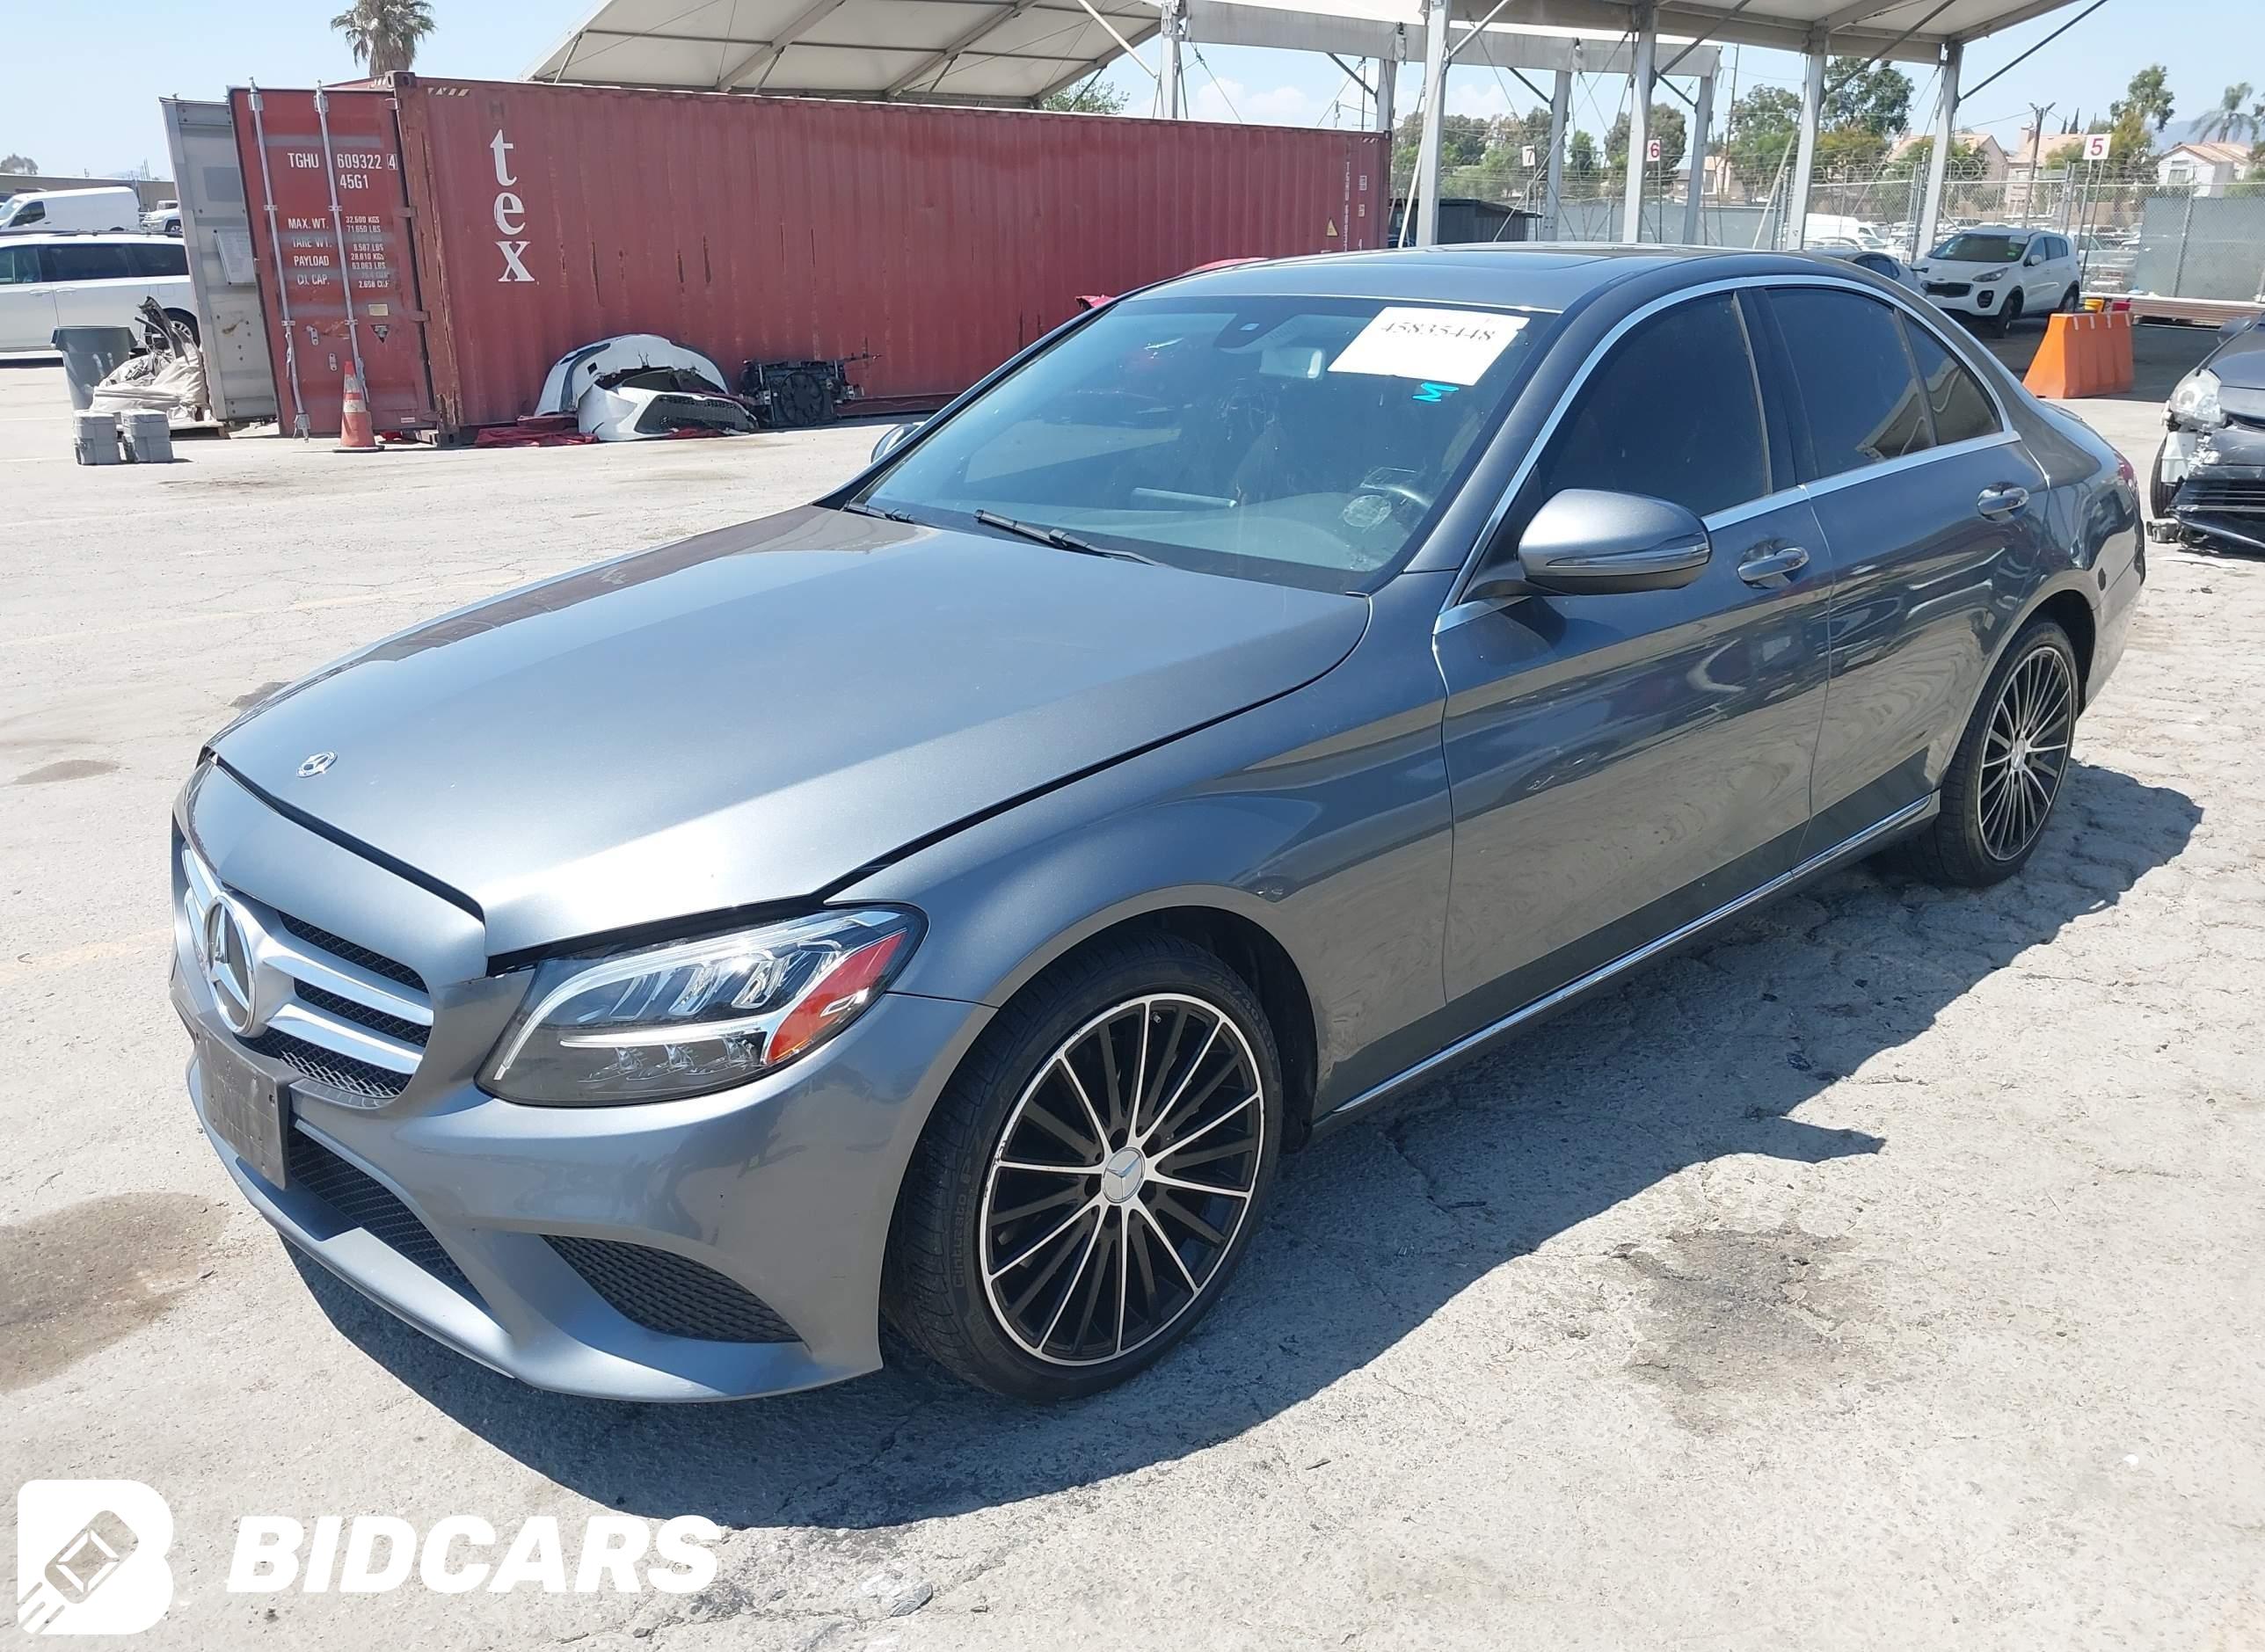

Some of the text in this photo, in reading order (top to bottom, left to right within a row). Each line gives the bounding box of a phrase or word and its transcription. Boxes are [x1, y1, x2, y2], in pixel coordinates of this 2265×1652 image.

[1650, 142, 1660, 158] 6
[2090, 137, 2104, 156] 5
[287, 152, 398, 171] TGHU 609322 4
[1526, 148, 1534, 164] 7
[339, 174, 369, 190] 45G1
[288, 217, 311, 229] MAX.
[312, 217, 330, 229] WT.
[294, 255, 330, 266] PAYLOAD
[311, 273, 330, 287] CAP.
[1380, 322, 1496, 342] 45835448
